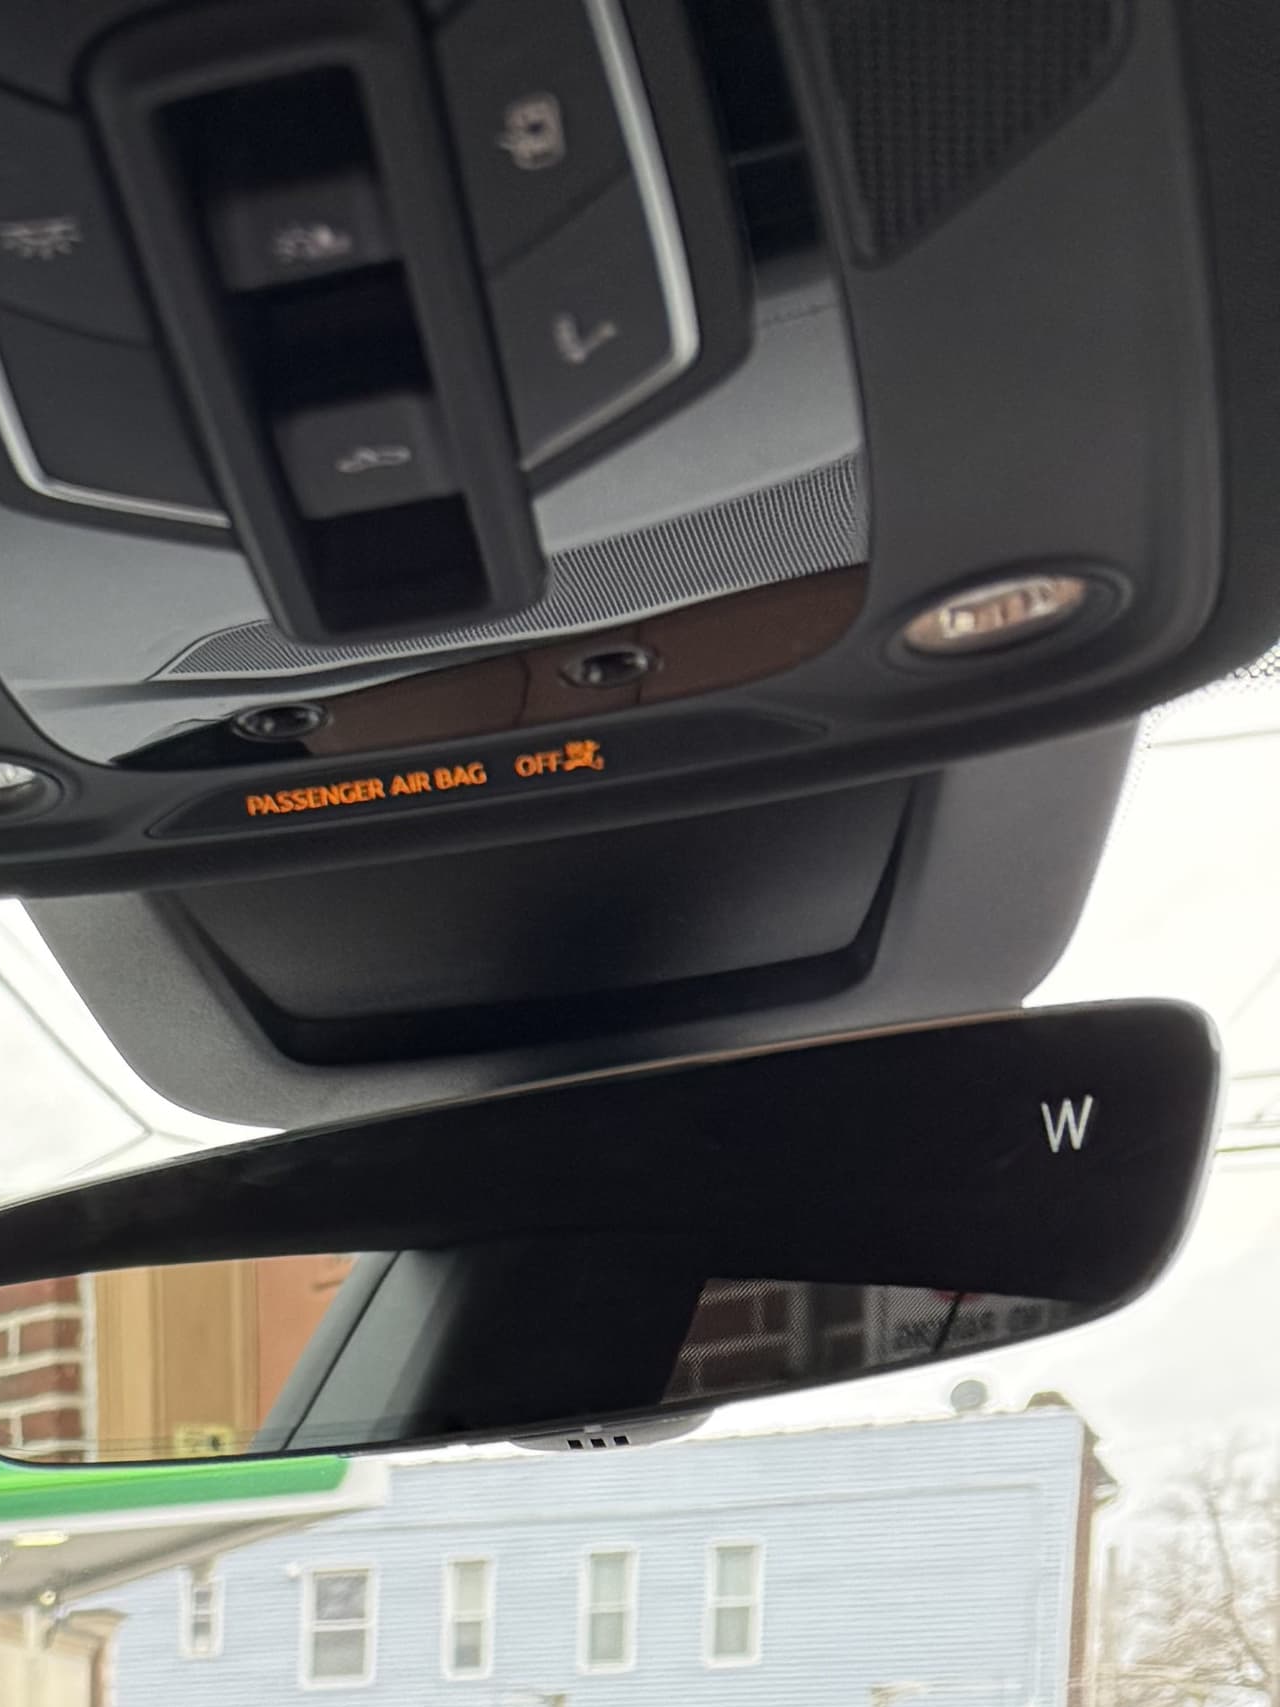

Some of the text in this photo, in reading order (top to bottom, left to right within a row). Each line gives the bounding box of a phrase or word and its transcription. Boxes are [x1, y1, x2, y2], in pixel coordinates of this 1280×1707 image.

[248, 751, 560, 814] PASSENGER AIR BAG OFF
[1042, 1096, 1092, 1152] W
